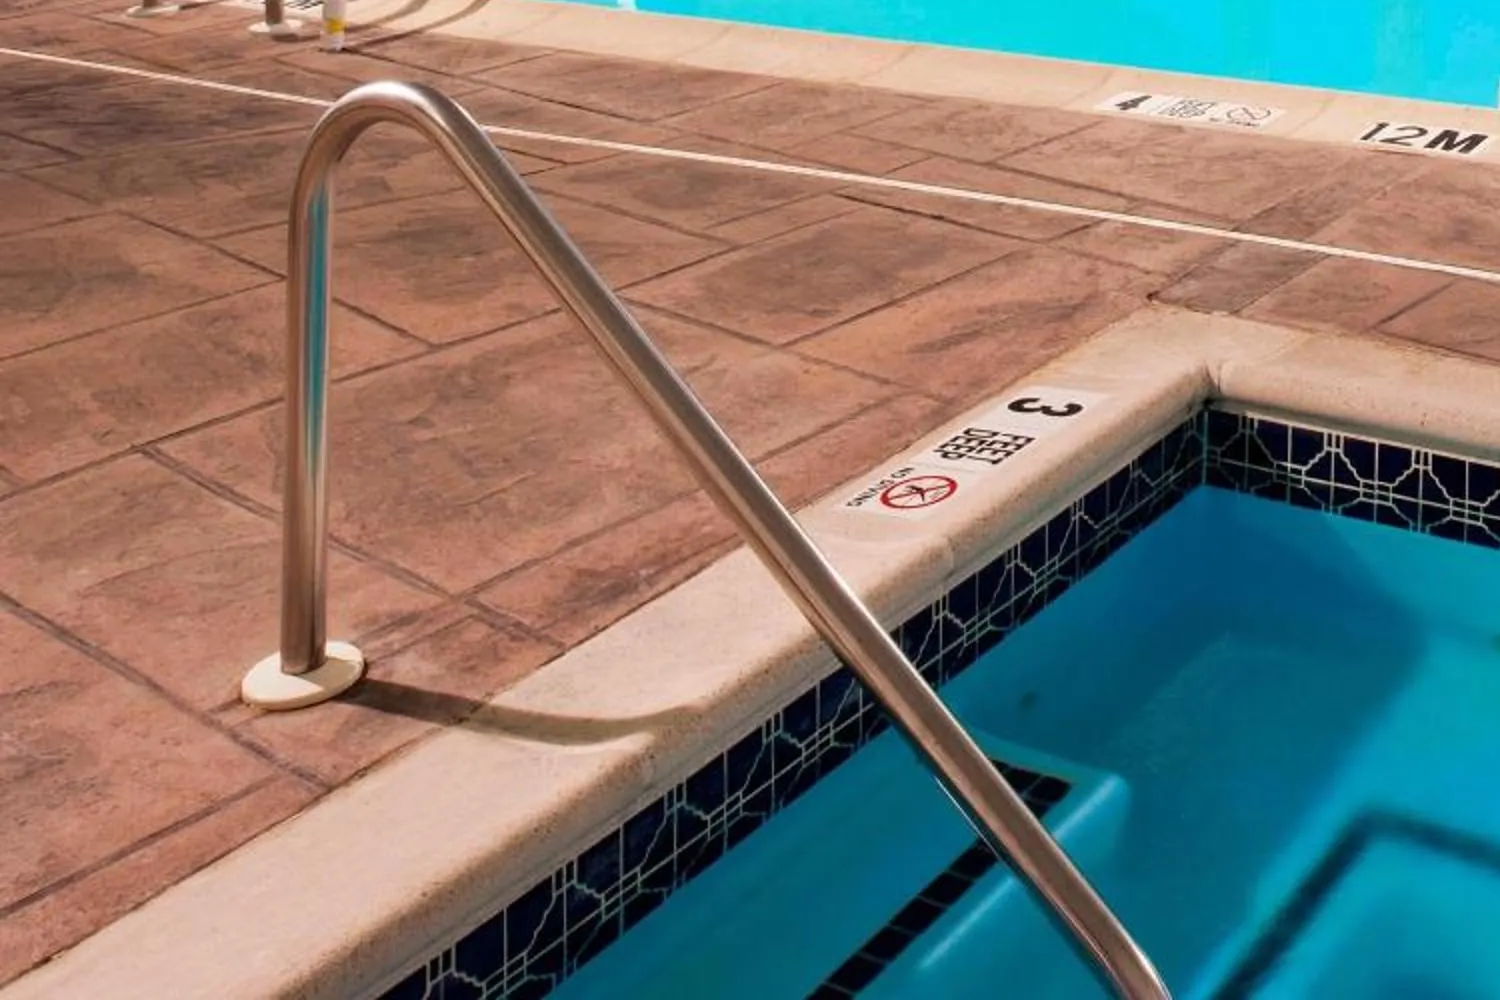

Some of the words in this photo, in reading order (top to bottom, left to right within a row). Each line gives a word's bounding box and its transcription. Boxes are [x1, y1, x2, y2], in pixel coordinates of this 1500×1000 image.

[1007, 398, 1083, 417] 3
[933, 428, 1000, 460] DEEP
[968, 433, 1035, 465] FEET
